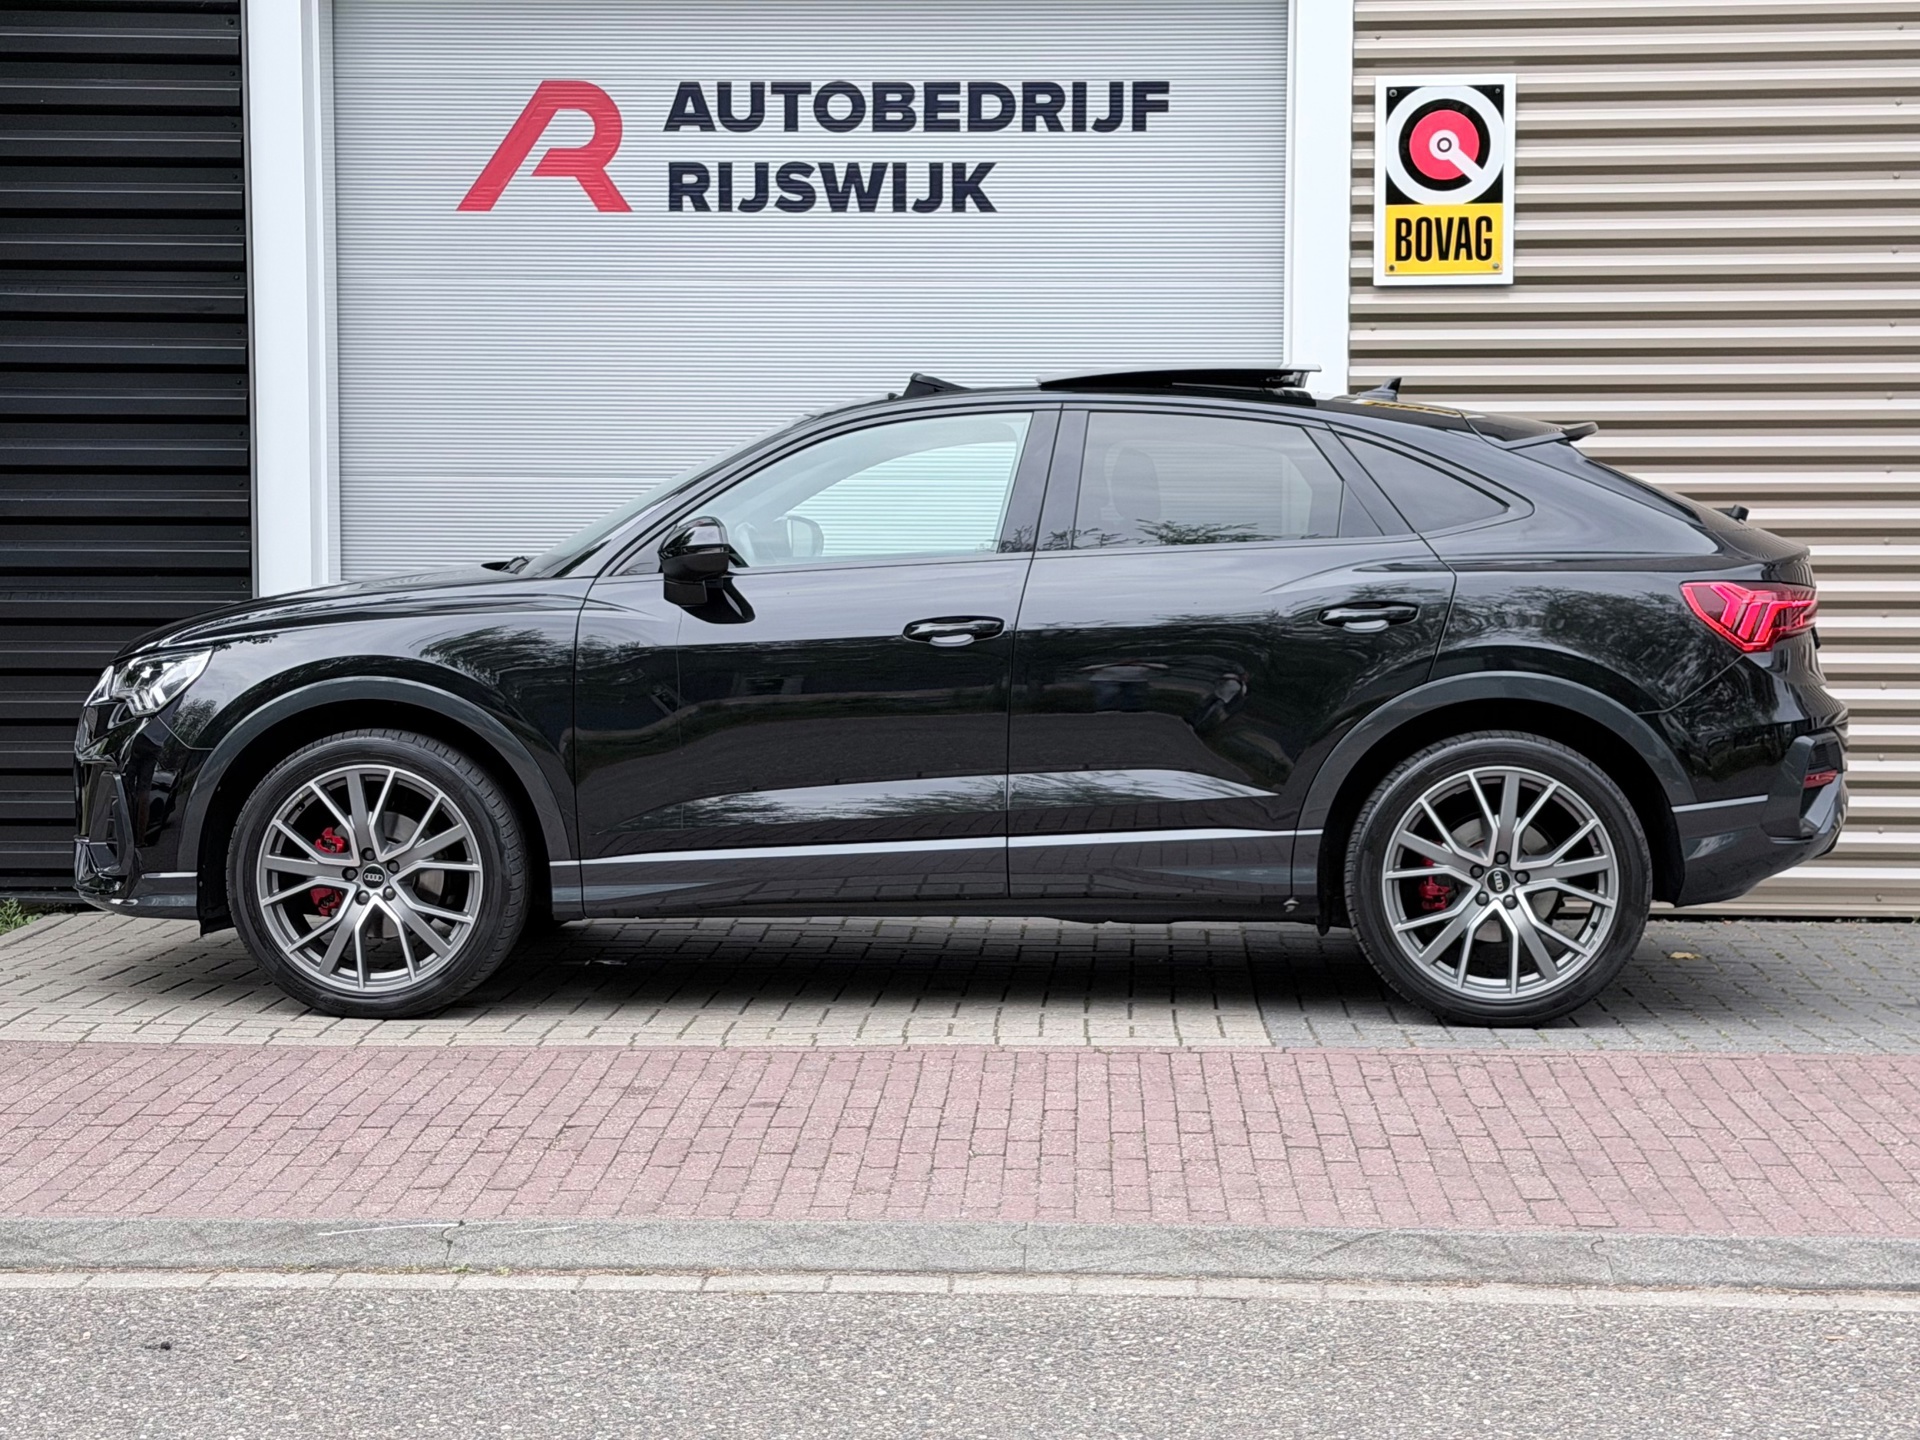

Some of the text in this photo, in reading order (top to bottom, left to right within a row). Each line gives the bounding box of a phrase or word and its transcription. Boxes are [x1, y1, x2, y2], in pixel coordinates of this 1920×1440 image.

[664, 81, 1170, 133] AUTOBEDRIJF
[668, 161, 997, 213] RIJSWIJK
[1395, 216, 1493, 262] BOVAG
